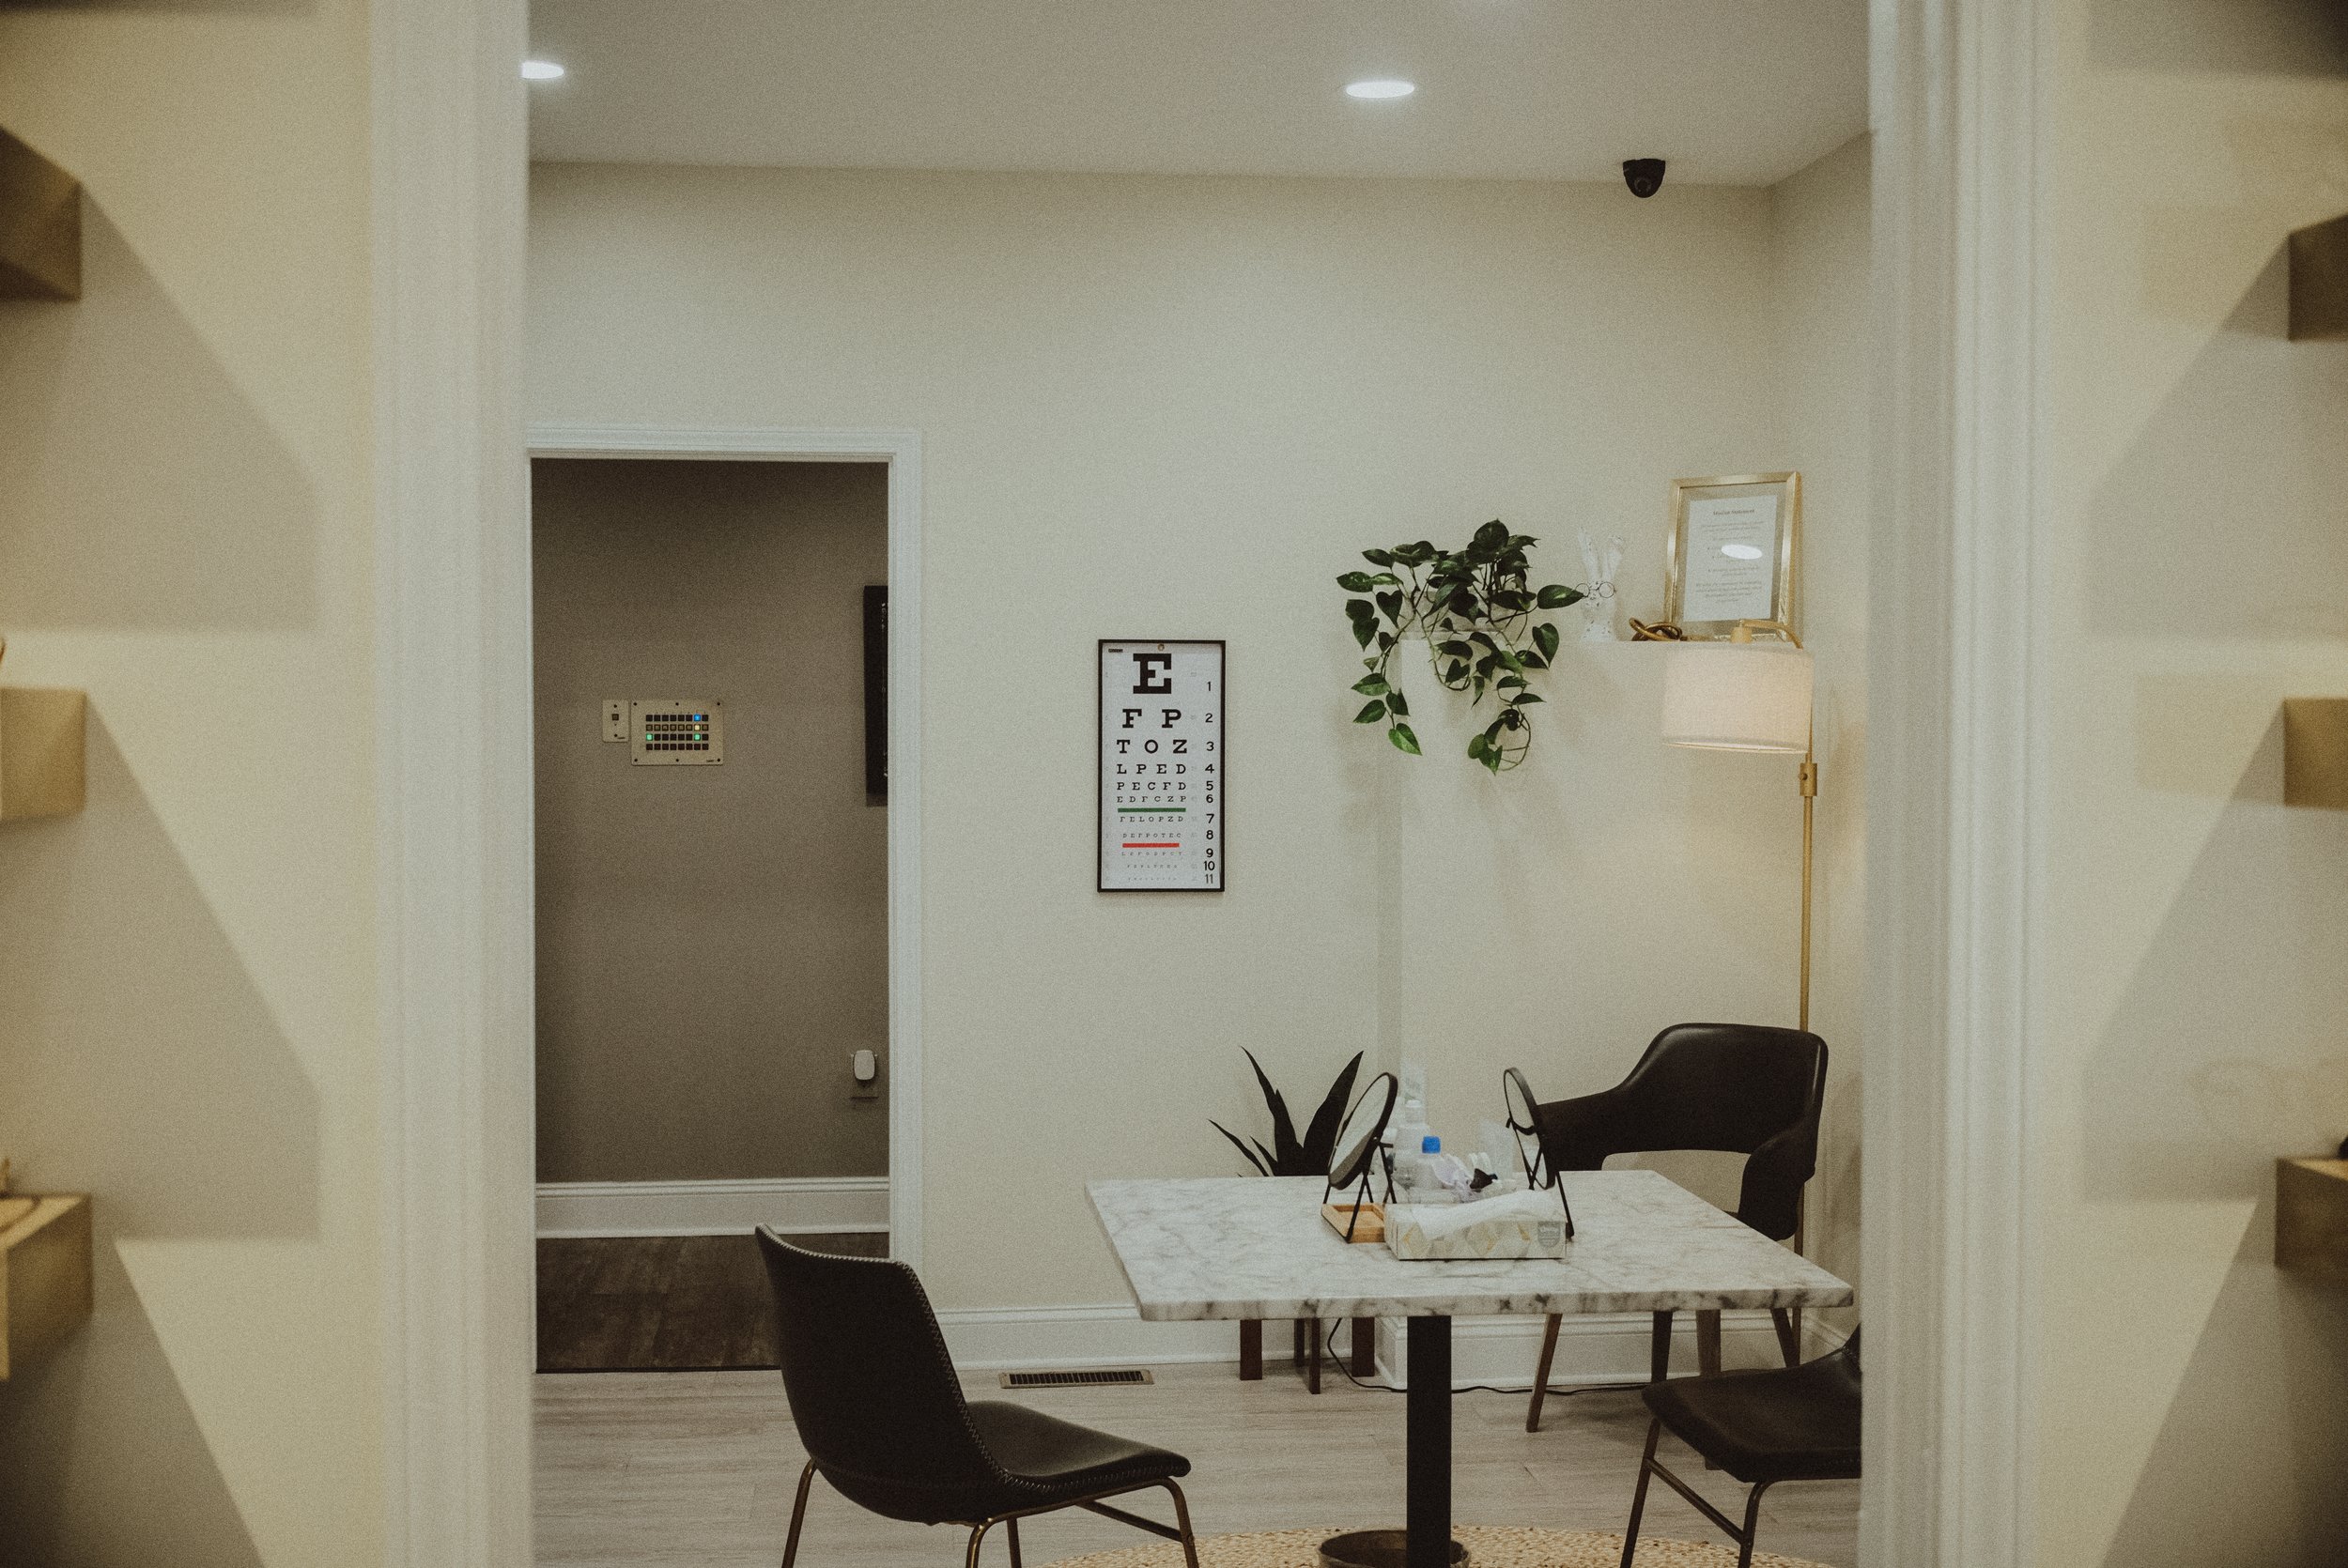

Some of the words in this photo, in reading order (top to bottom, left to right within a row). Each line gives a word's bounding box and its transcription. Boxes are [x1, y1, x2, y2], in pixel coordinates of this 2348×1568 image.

[1133, 653, 1172, 695] E
[1206, 681, 1212, 692] 1
[1204, 713, 1213, 723] 2
[1206, 741, 1214, 752] 3
[1204, 763, 1215, 775] 4
[1206, 780, 1214, 791] 5
[1206, 793, 1214, 804] 6
[1205, 813, 1215, 824] 7
[1206, 829, 1214, 840] 8
[1206, 848, 1214, 858] 9
[1203, 860, 1215, 871] 10
[1205, 873, 1214, 884] 11
